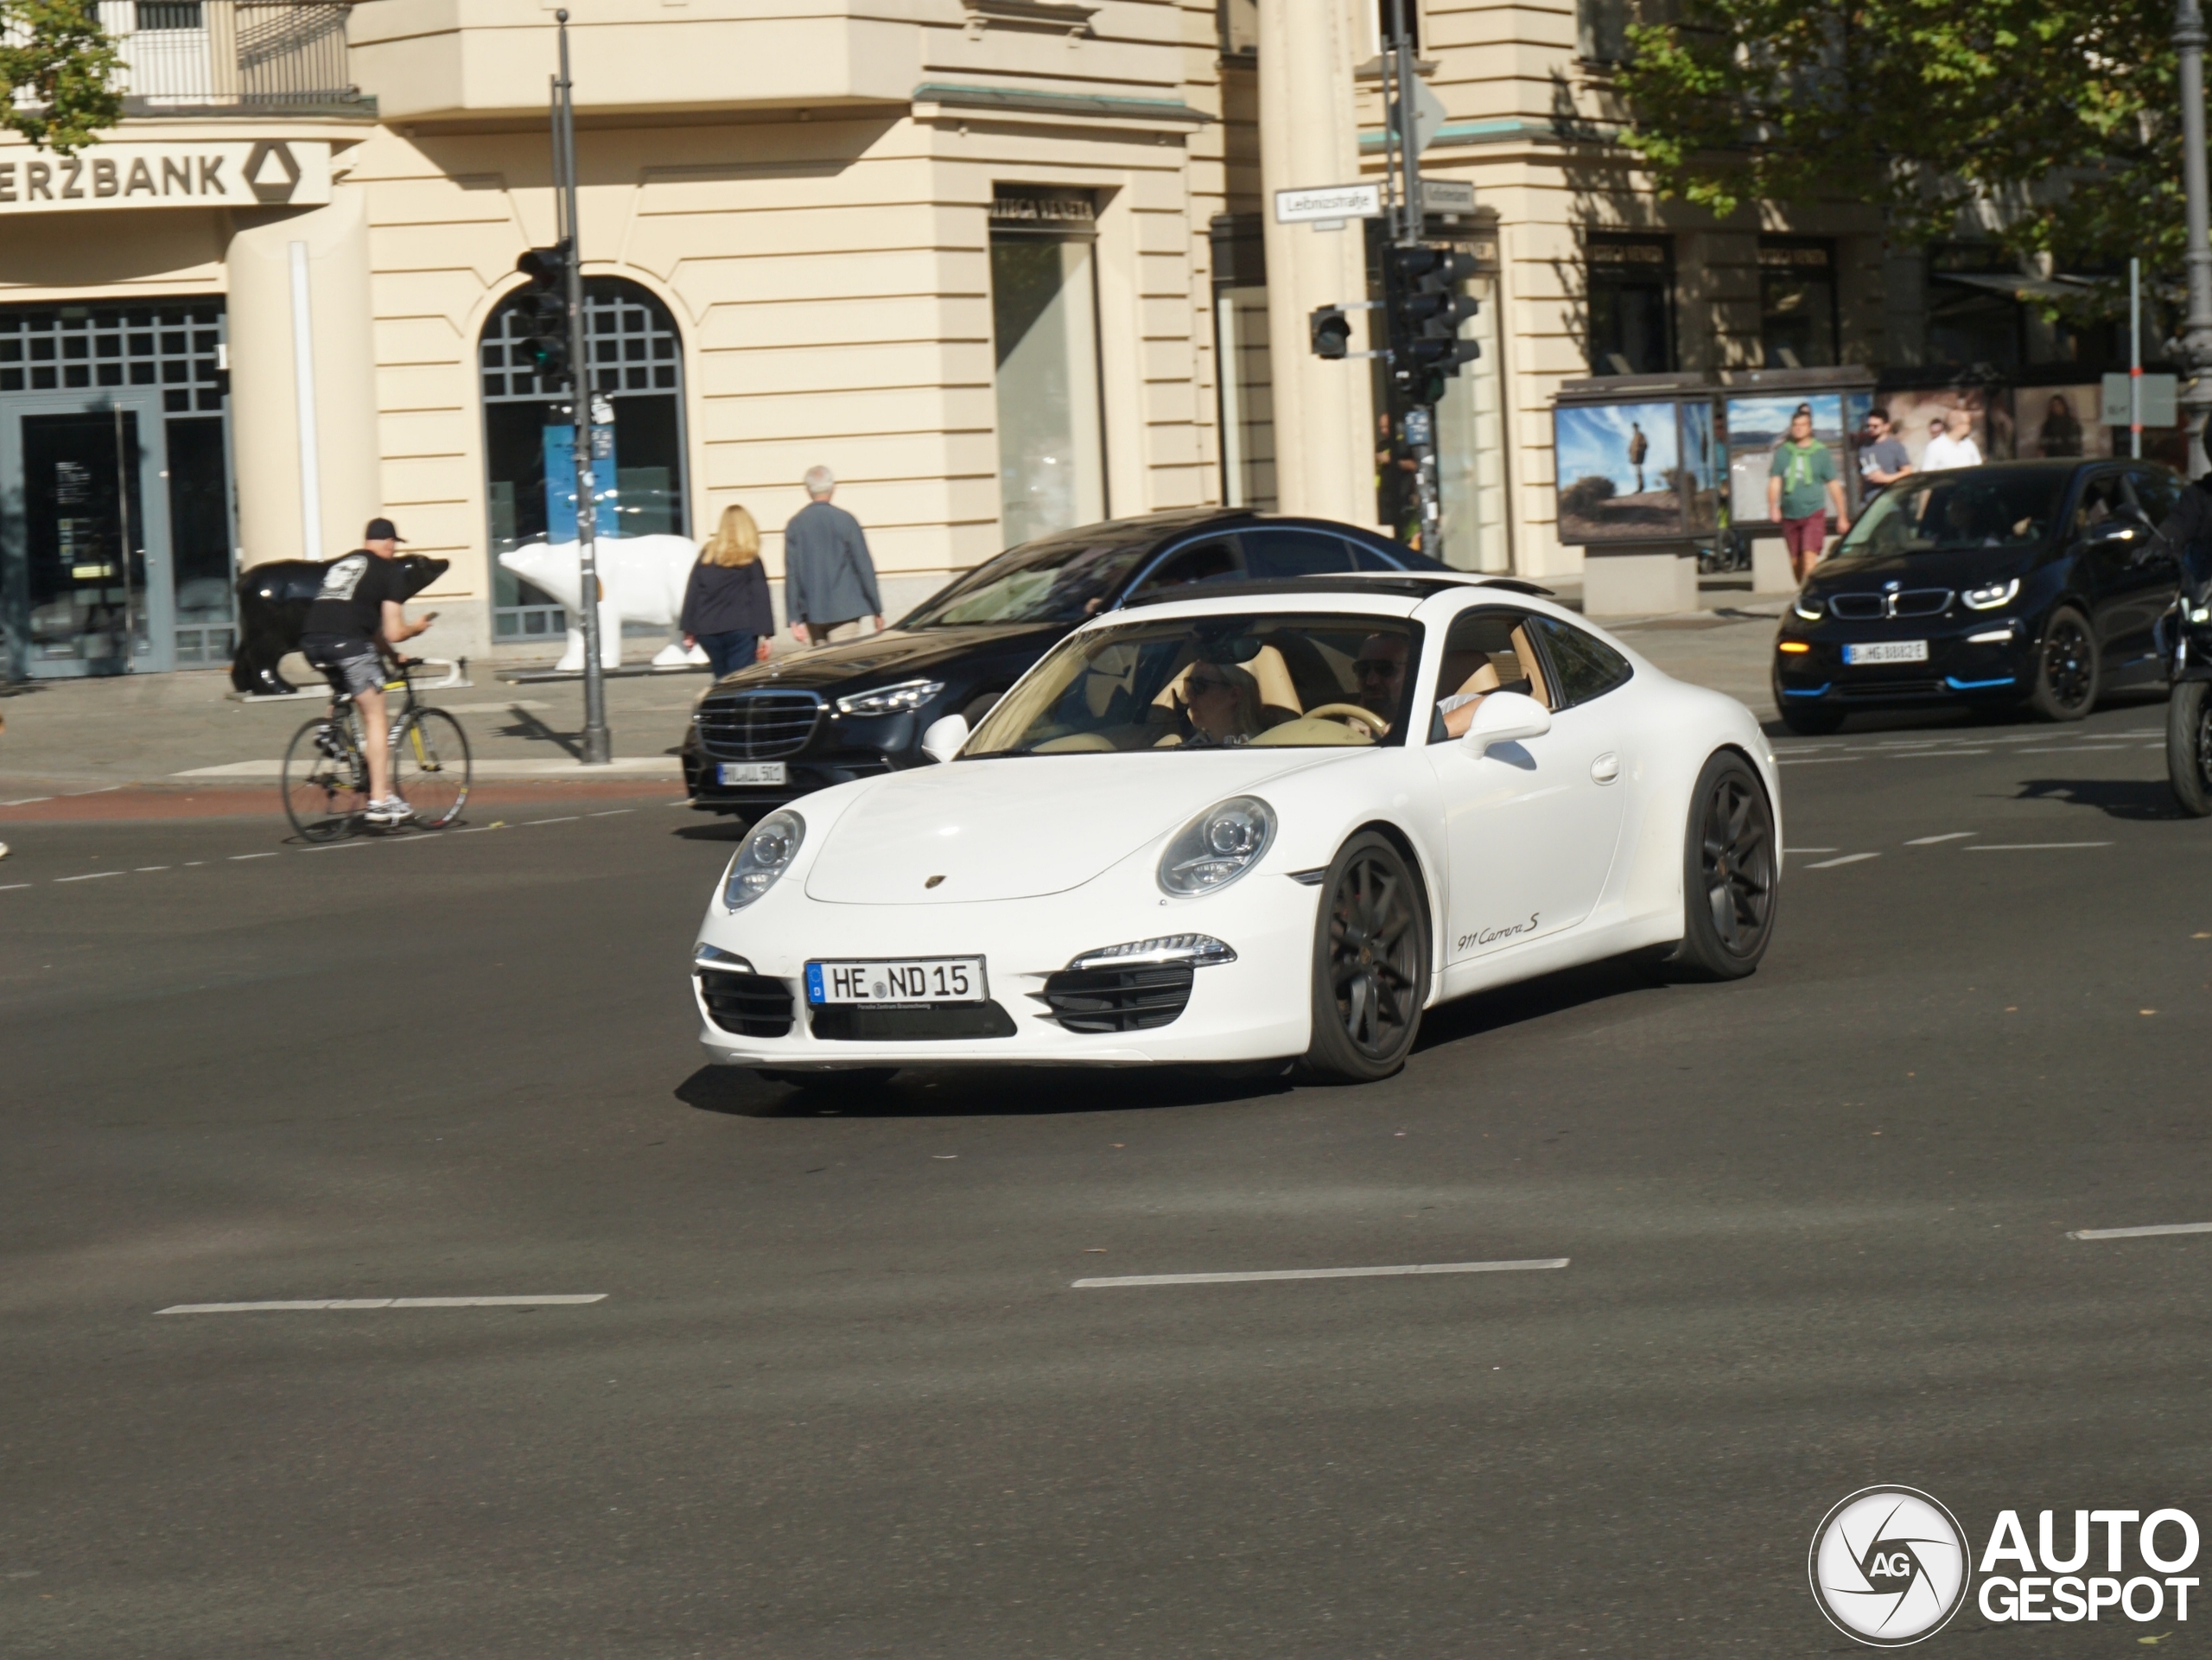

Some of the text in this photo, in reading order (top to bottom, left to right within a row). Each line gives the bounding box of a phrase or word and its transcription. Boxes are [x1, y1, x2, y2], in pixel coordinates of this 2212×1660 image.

[1286, 191, 1370, 213] Leibnizstraße
[1458, 912, 1540, 951] 911 Carrera S
[832, 965, 969, 998] HE ND 15
